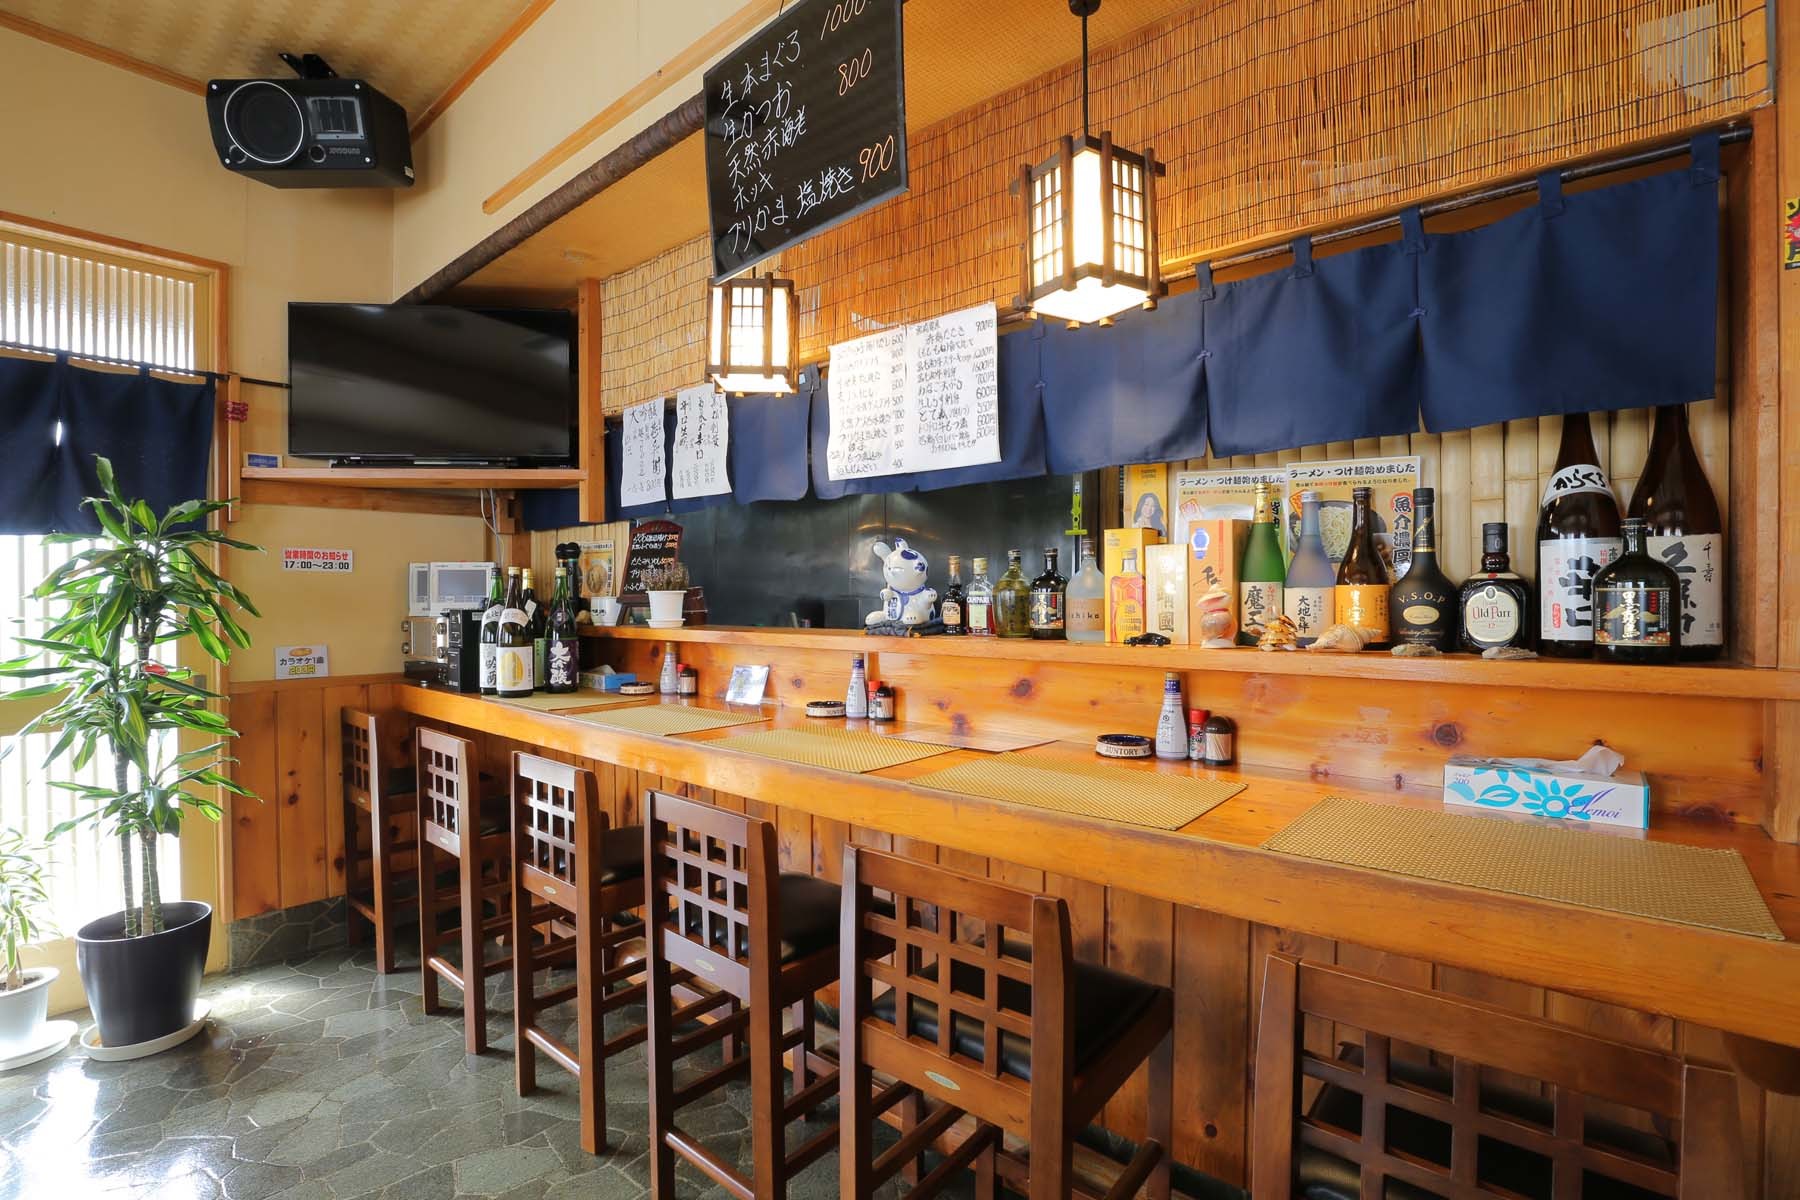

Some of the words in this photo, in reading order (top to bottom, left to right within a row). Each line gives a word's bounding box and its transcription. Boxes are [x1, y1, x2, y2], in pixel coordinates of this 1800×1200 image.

[721, 29, 801, 119] 生本まぐろ
[724, 80, 792, 156] 生かつお
[838, 47, 873, 96] 800
[859, 135, 894, 184] 900
[1244, 586, 1266, 627] 魔王
